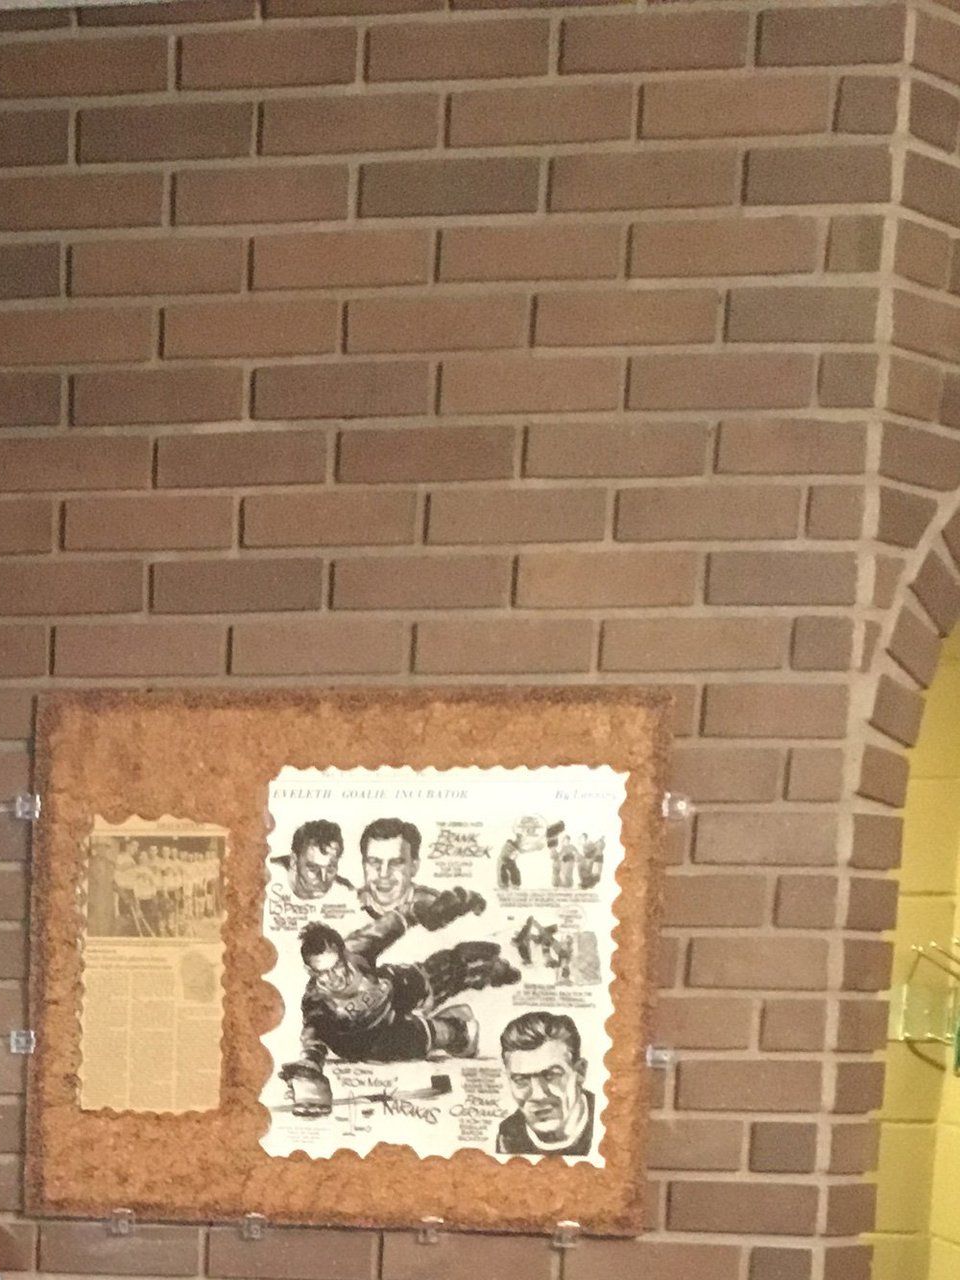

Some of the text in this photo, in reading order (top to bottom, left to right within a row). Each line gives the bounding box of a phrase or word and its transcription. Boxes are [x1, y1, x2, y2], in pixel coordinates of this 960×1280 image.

[273, 789, 470, 799] EVELETH GOALIE INCUBATOR
